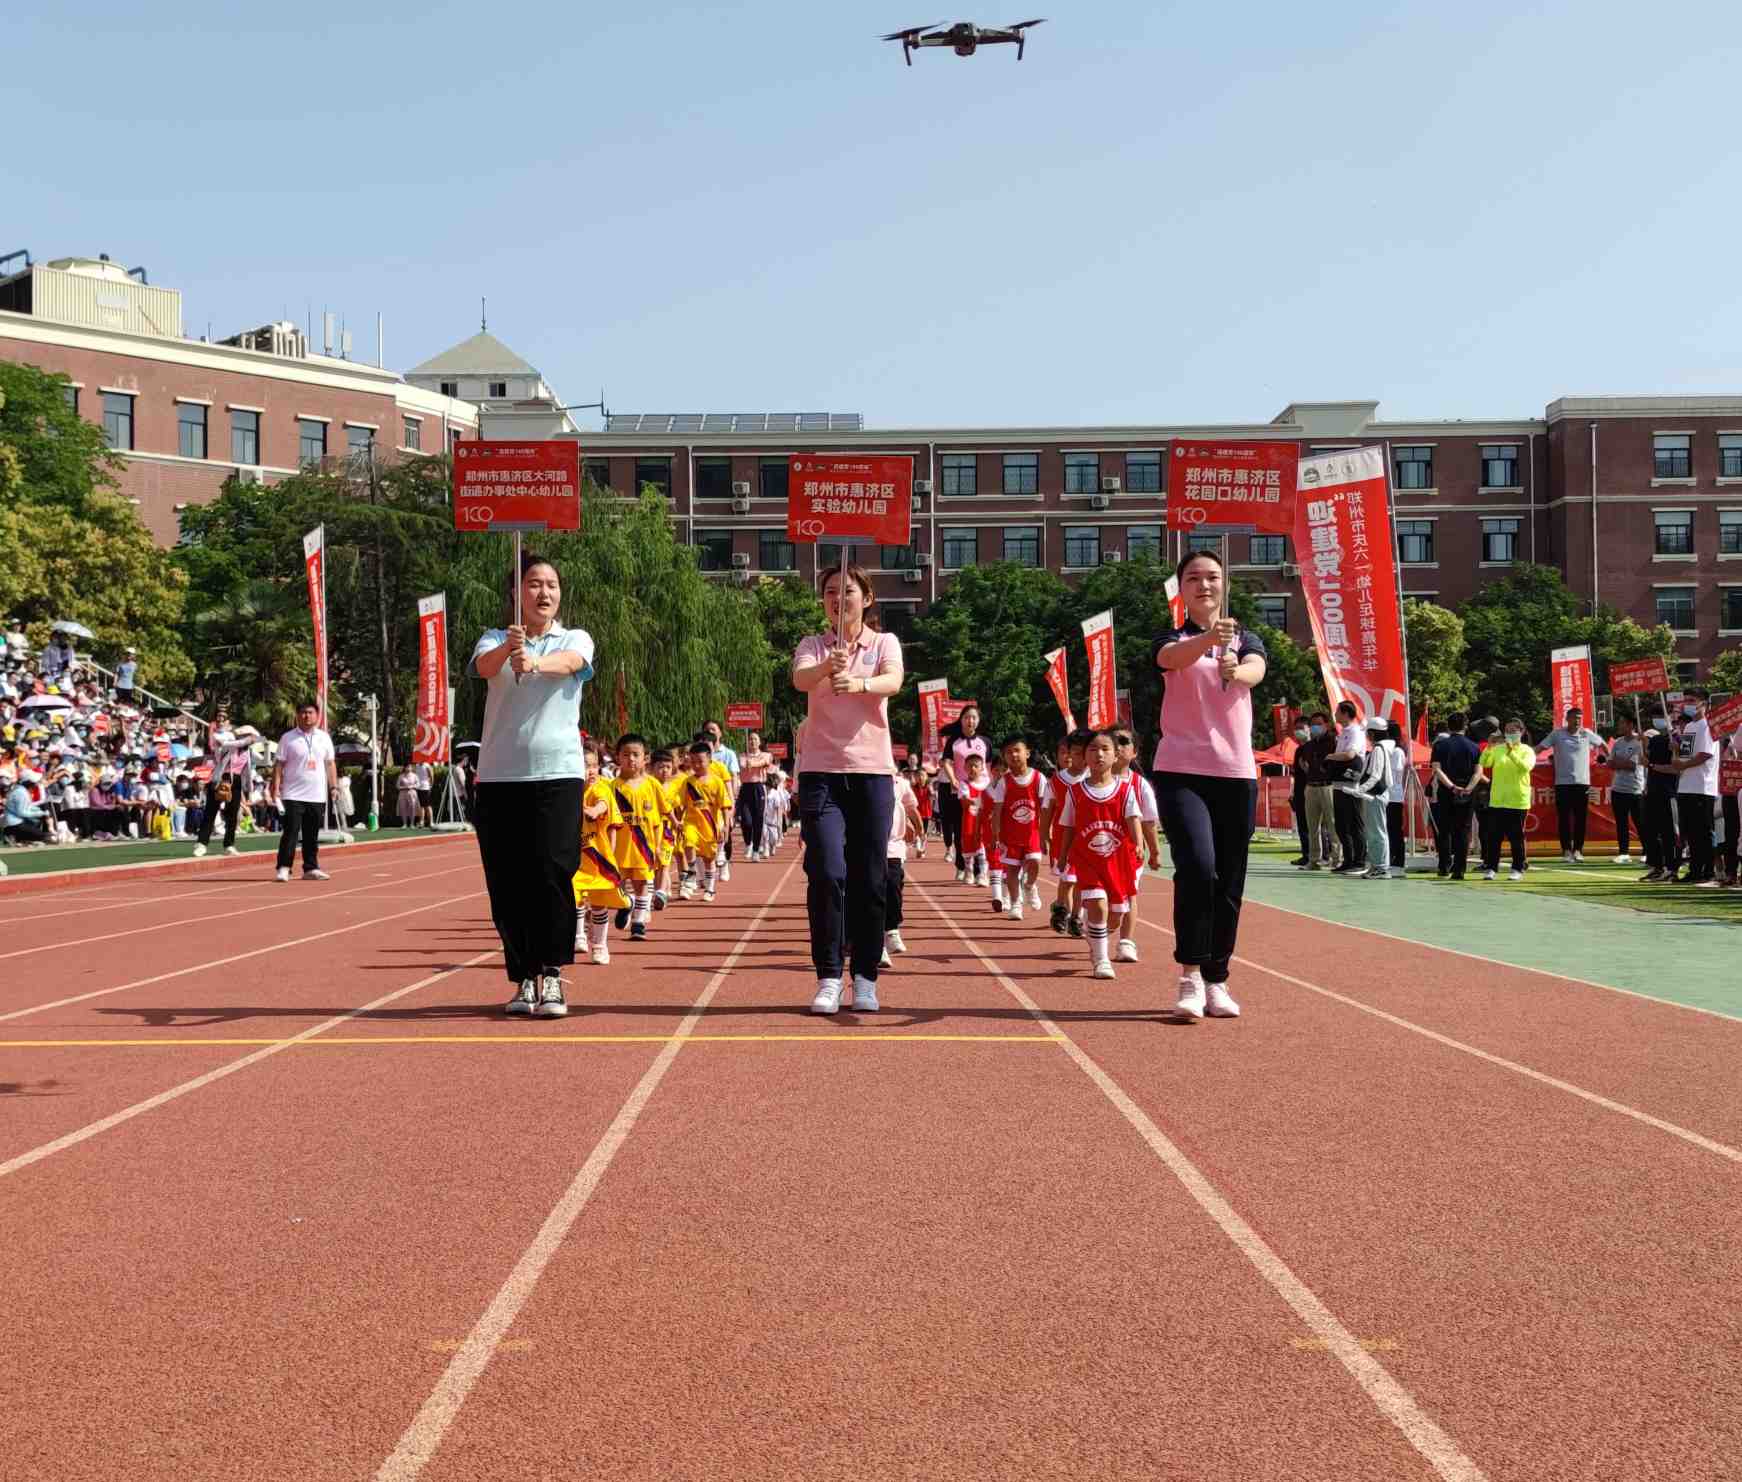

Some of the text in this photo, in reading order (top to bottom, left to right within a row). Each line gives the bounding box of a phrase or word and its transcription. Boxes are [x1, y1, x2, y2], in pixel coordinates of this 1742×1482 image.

[464, 470, 568, 482] 郑州市惠济区大河路
[1185, 467, 1281, 485] 郑州市惠济区
[460, 485, 574, 497] 街道办事处中心幼儿园
[803, 481, 895, 498] 郑州市惠济区
[1184, 485, 1280, 503] 花园口幼儿园
[811, 499, 888, 515] 实验幼儿园
